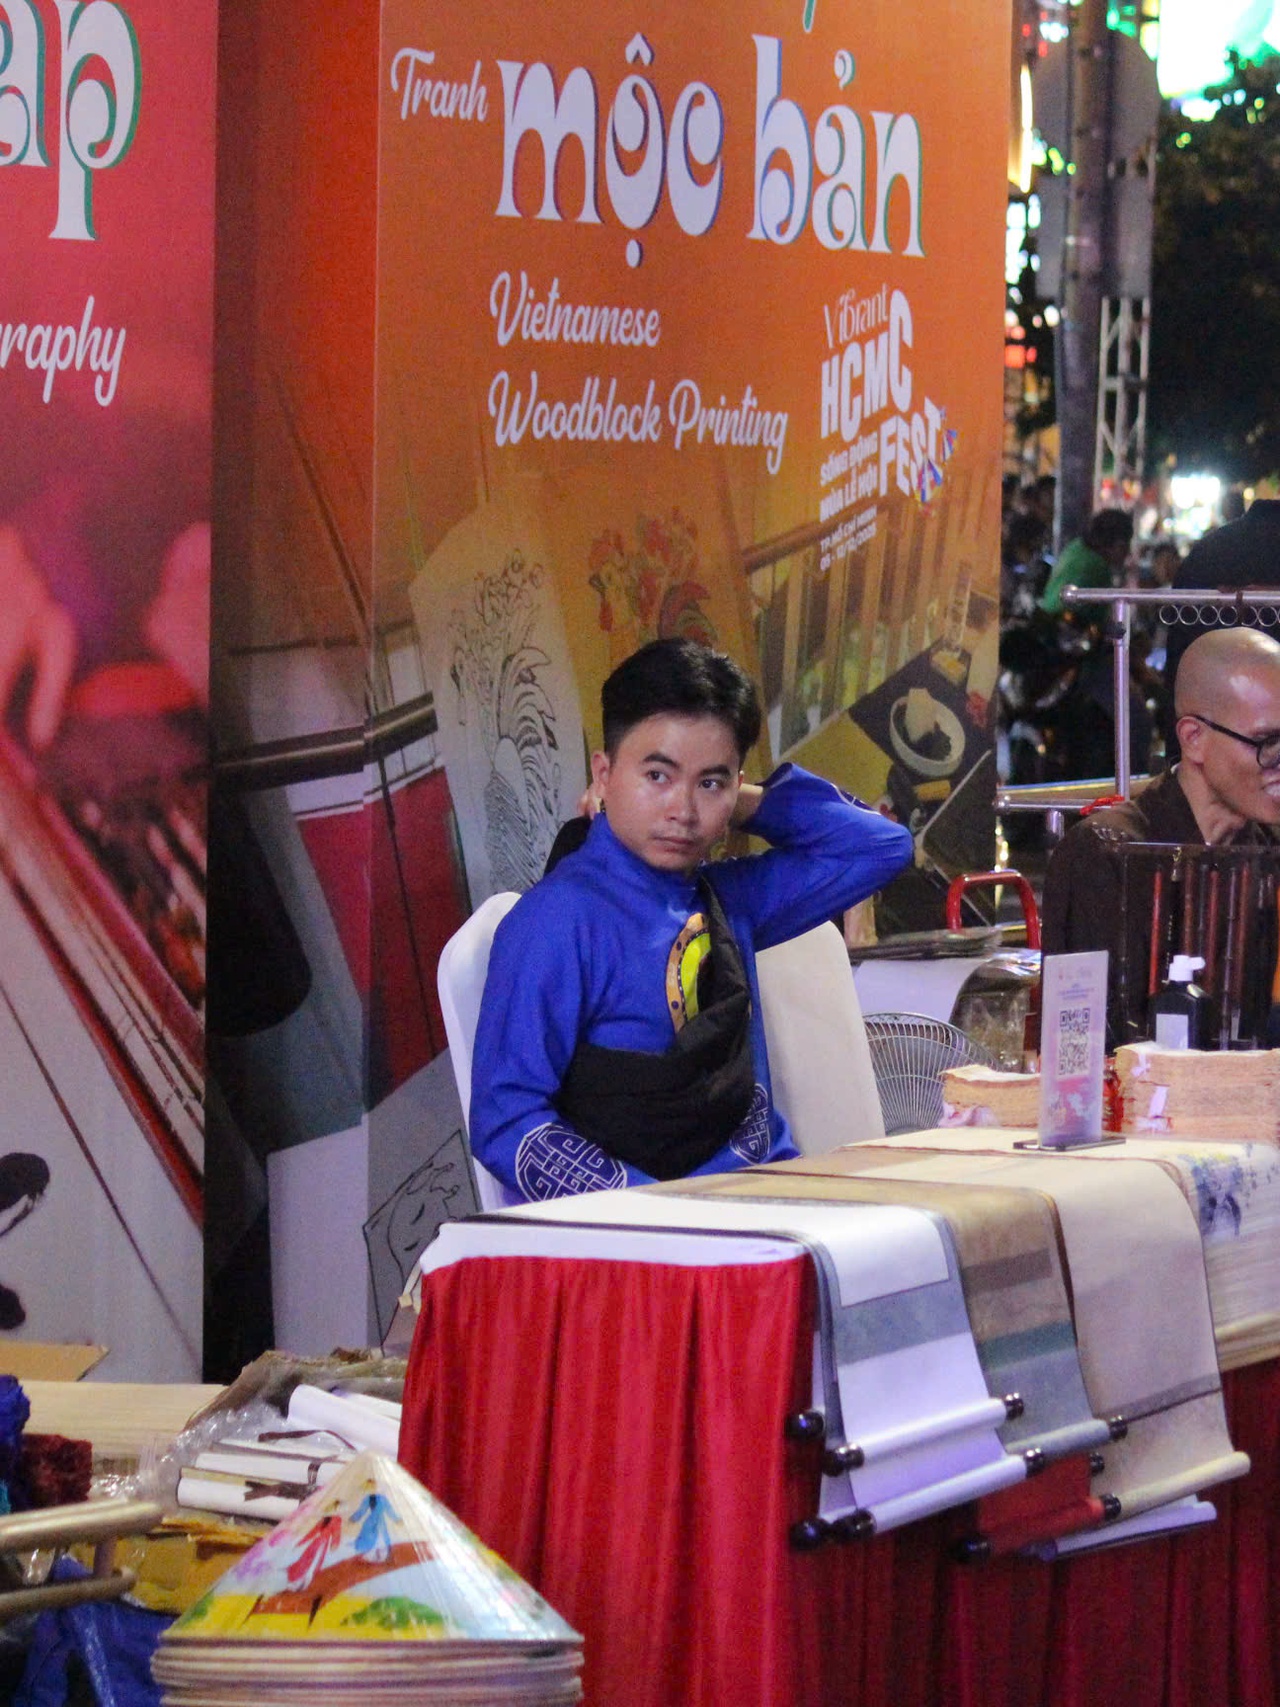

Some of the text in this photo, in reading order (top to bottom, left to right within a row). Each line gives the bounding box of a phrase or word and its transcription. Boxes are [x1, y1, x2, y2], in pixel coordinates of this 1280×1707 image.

[391, 31, 926, 269] Tranh mộc bản
[489, 270, 661, 348] Vietnamese
[823, 282, 889, 350] Vibrant
[821, 289, 913, 442] HCMC
[488, 370, 788, 476] Woodblock Printing
[879, 396, 943, 498] FEST
